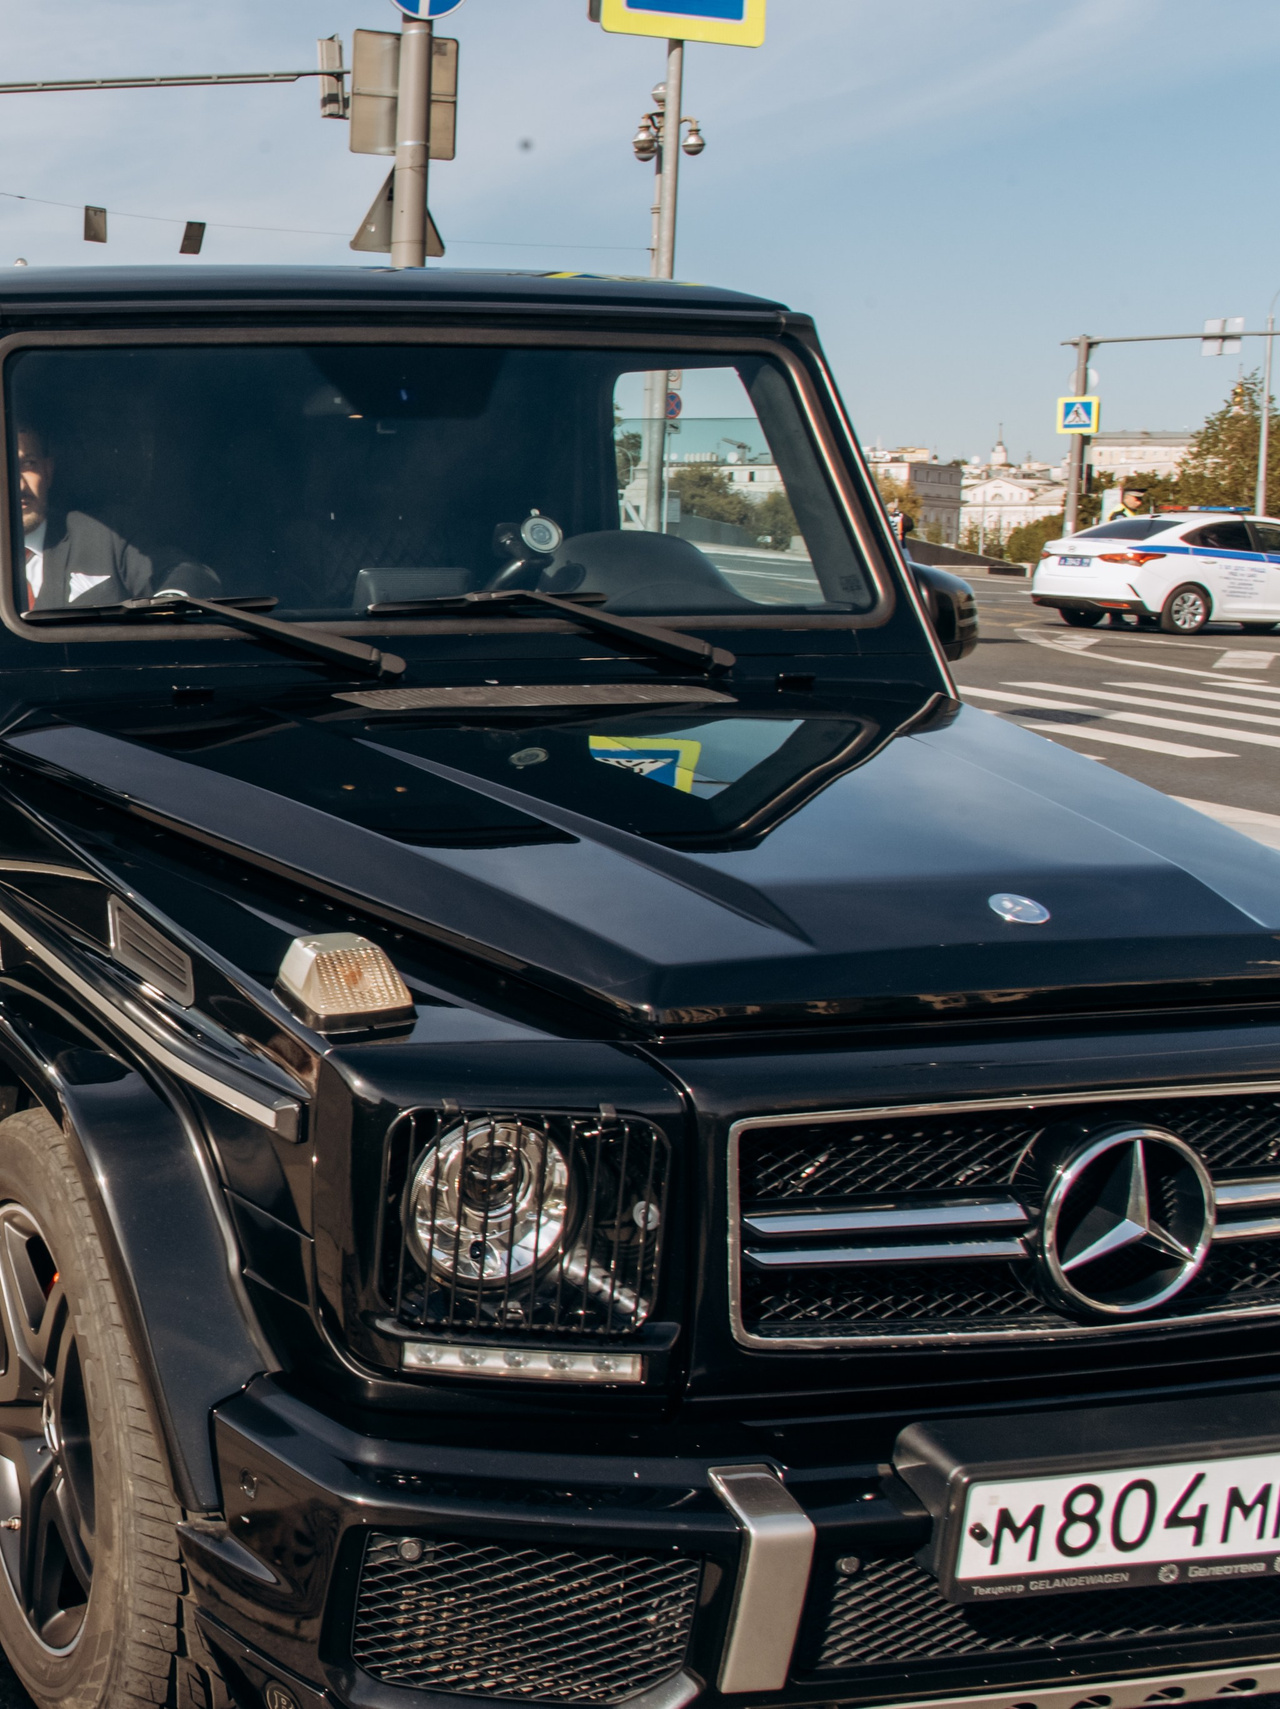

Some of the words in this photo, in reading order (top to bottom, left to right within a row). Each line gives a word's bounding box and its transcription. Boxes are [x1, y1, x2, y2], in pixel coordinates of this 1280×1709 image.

[988, 1472, 1280, 1566] М804М
[971, 1584, 1025, 1596] Техцентр
[1029, 1572, 1130, 1592] GELANDEWAGEN
